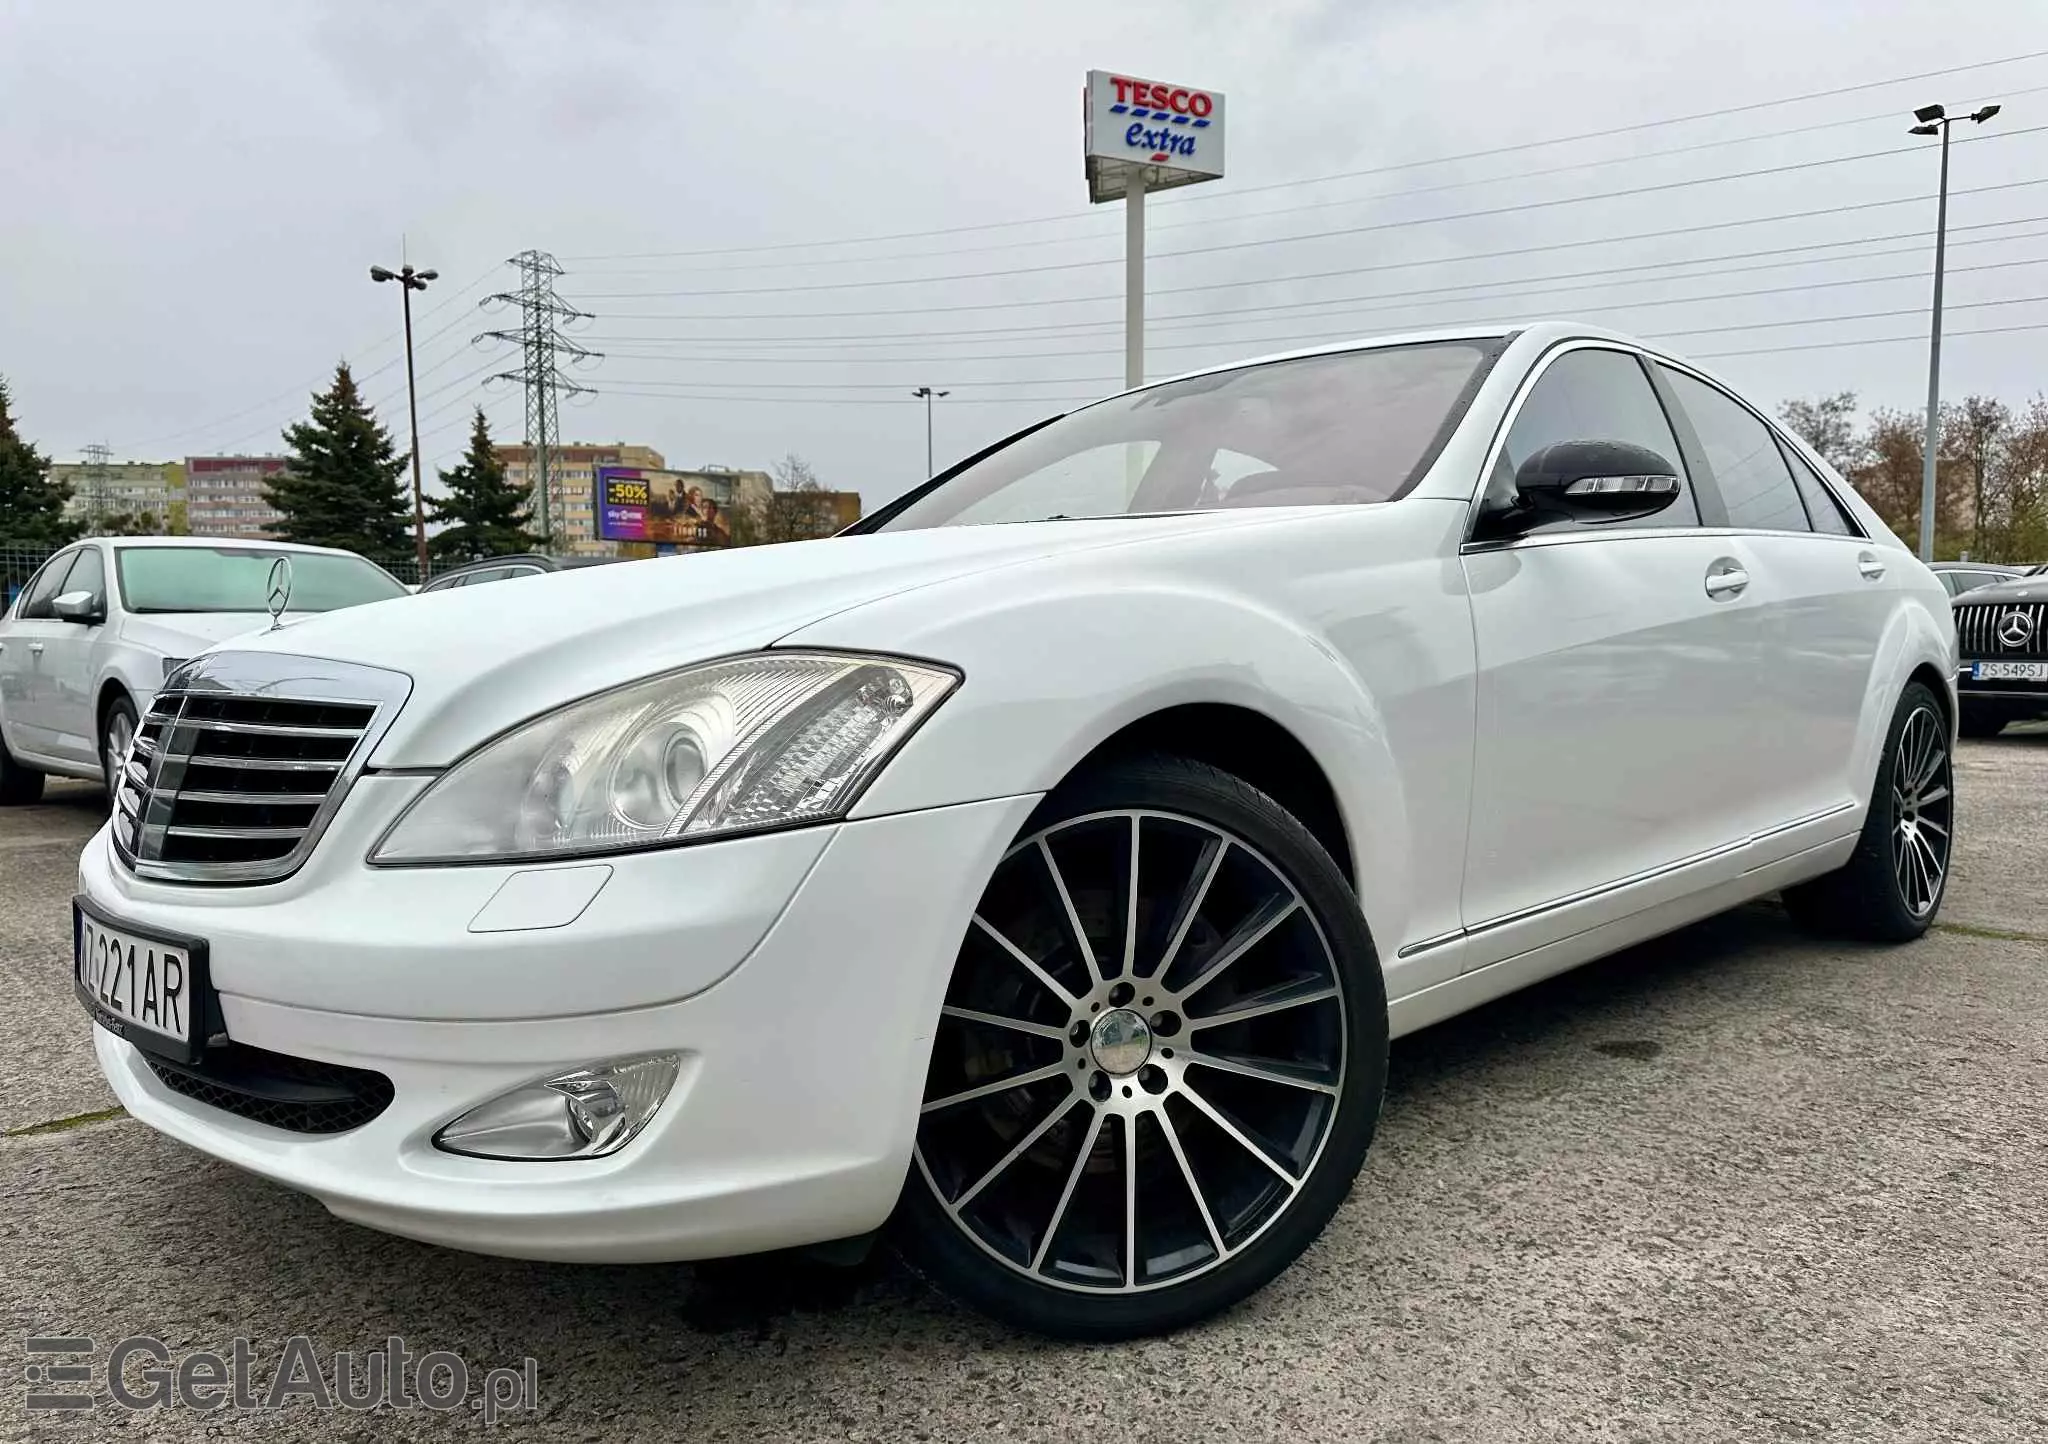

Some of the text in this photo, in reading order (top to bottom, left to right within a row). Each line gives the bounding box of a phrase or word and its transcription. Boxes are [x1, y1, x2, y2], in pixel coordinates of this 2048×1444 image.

[1110, 77, 1212, 117] TESCO
[1125, 122, 1196, 156] extra
[608, 484, 648, 500] -50%
[99, 933, 183, 1034] 221AR
